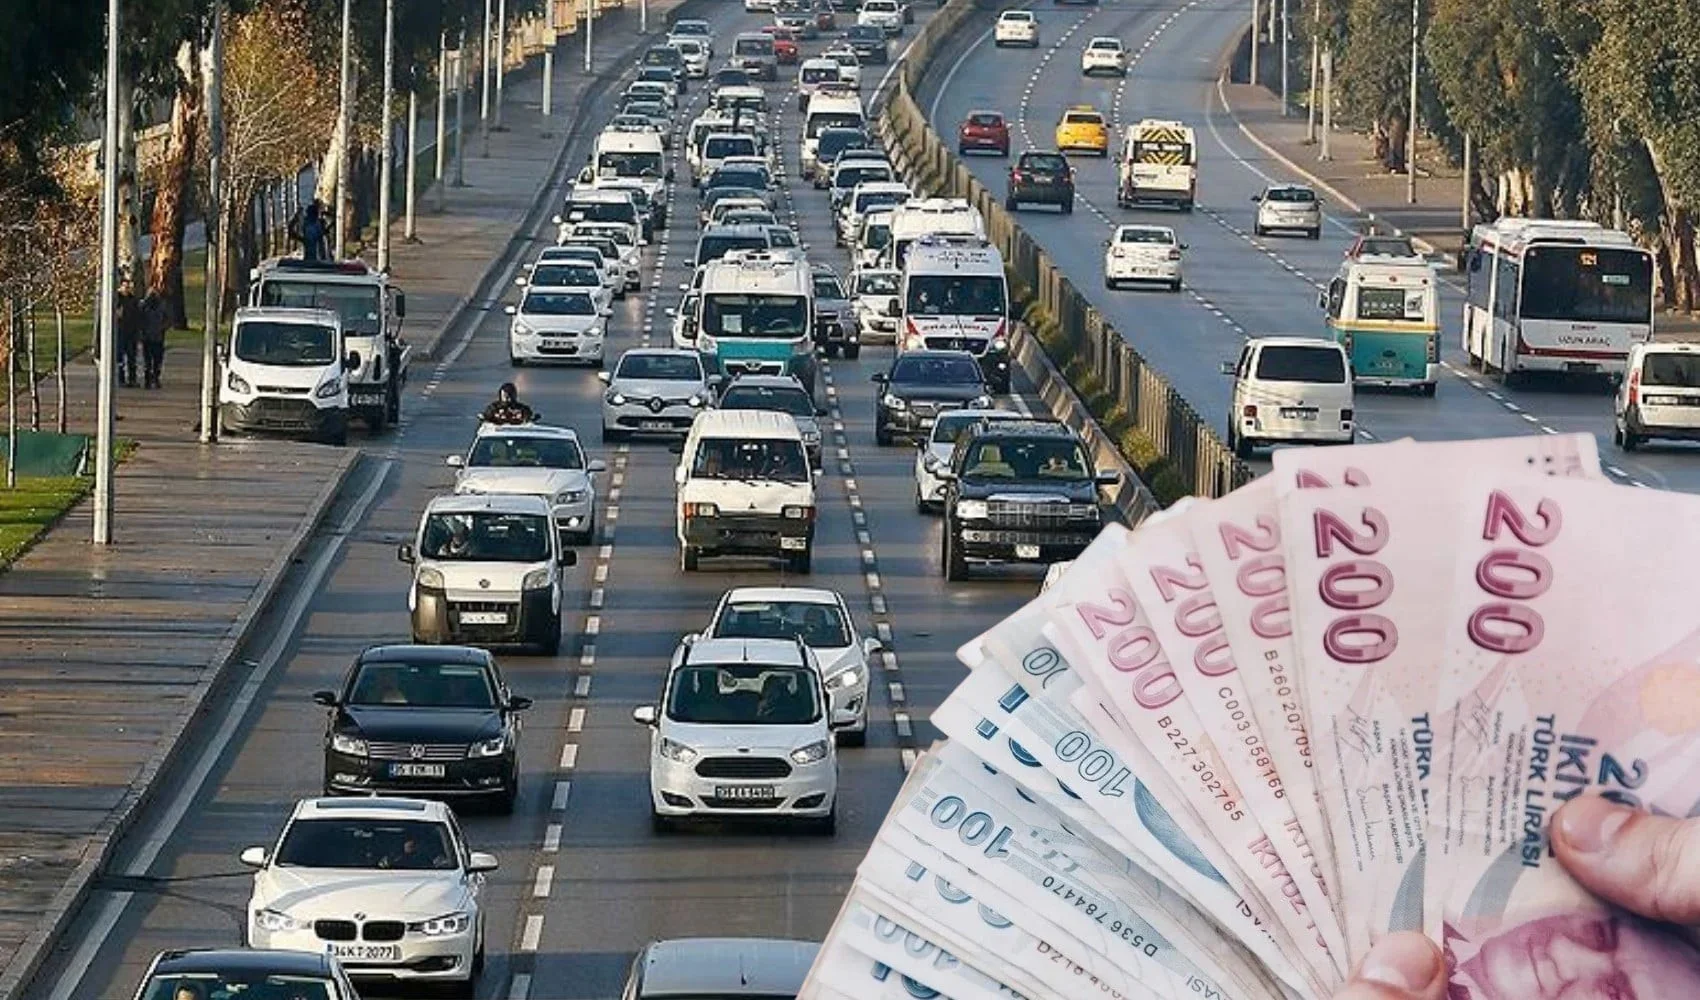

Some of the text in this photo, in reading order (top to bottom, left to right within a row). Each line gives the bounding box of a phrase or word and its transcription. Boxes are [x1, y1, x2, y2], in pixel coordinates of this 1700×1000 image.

[1149, 552, 1238, 677] 200
[1219, 514, 1293, 639] 200
[1313, 506, 1399, 664] 200
[1467, 488, 1563, 655] 200
[1076, 588, 1184, 709] 200
[1264, 650, 1291, 697] B260
[1218, 686, 1250, 732] C003
[1055, 730, 1131, 798] 100
[1157, 715, 1245, 822] B227 302765
[1522, 714, 1556, 868] TÜRK LİRASI
[930, 795, 1014, 859] 100
[1043, 876, 1109, 924] 784470
[1110, 920, 1158, 958] D536
